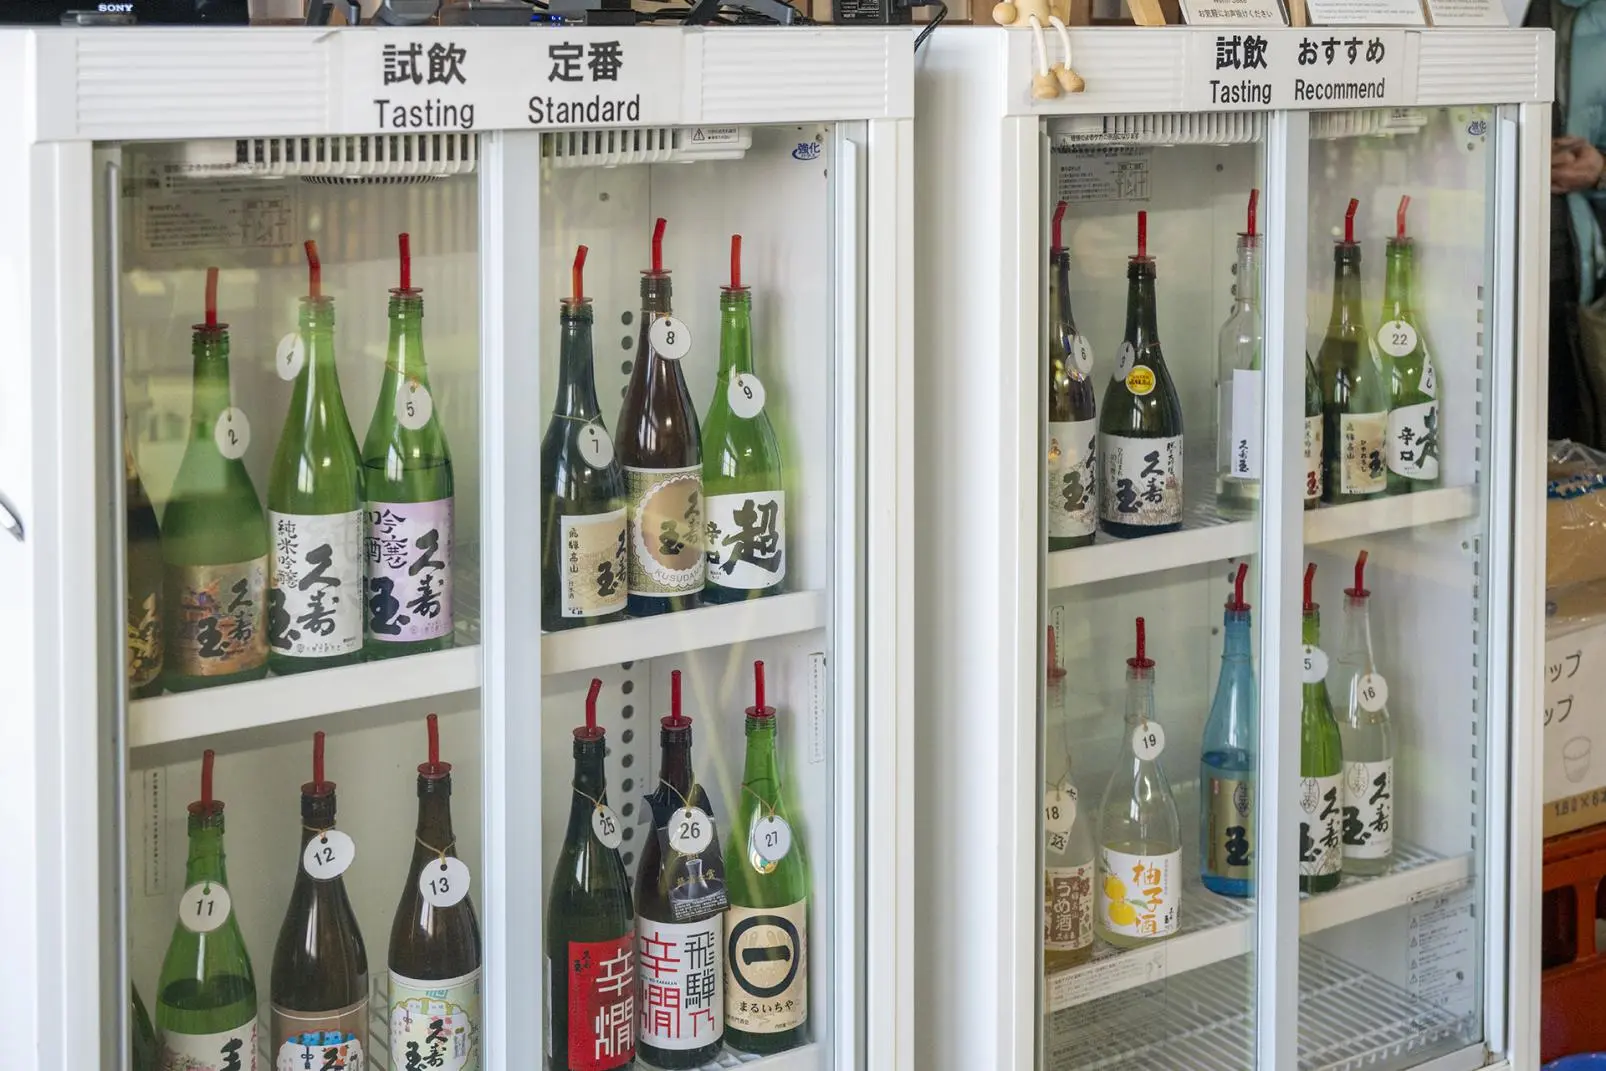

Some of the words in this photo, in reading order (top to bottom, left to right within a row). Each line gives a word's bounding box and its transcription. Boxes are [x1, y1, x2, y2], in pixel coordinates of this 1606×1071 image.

[98, 4, 133, 12] SONY
[1216, 35, 1268, 70] 試飲
[1298, 36, 1385, 65] おすすめ
[383, 42, 467, 85] 試飲
[548, 40, 623, 82] 定番
[1210, 80, 1272, 104] Tasting
[1295, 78, 1385, 101] Recommend
[374, 98, 474, 129] Tasting
[528, 94, 640, 124] Standard
[797, 143, 820, 155] 強化
[666, 331, 675, 345] 8
[1392, 333, 1408, 345] 22
[743, 385, 753, 400] 9
[406, 401, 415, 417] 5
[228, 429, 238, 445] 2
[1398, 426, 1415, 461] 辛口
[592, 439, 600, 454] 7
[718, 499, 782, 575] 超
[1363, 687, 1376, 701] 16
[1142, 734, 1157, 749] 19
[1045, 806, 1060, 821] 18
[600, 817, 615, 835] 25
[680, 823, 701, 839] 26
[765, 831, 778, 847] 27
[313, 847, 336, 867] 12
[429, 877, 450, 896] 13
[1132, 860, 1163, 935] 柚子酒
[195, 900, 215, 917] 11
[1054, 881, 1073, 932] うめ酒
[740, 1000, 794, 1014] まるいちや
